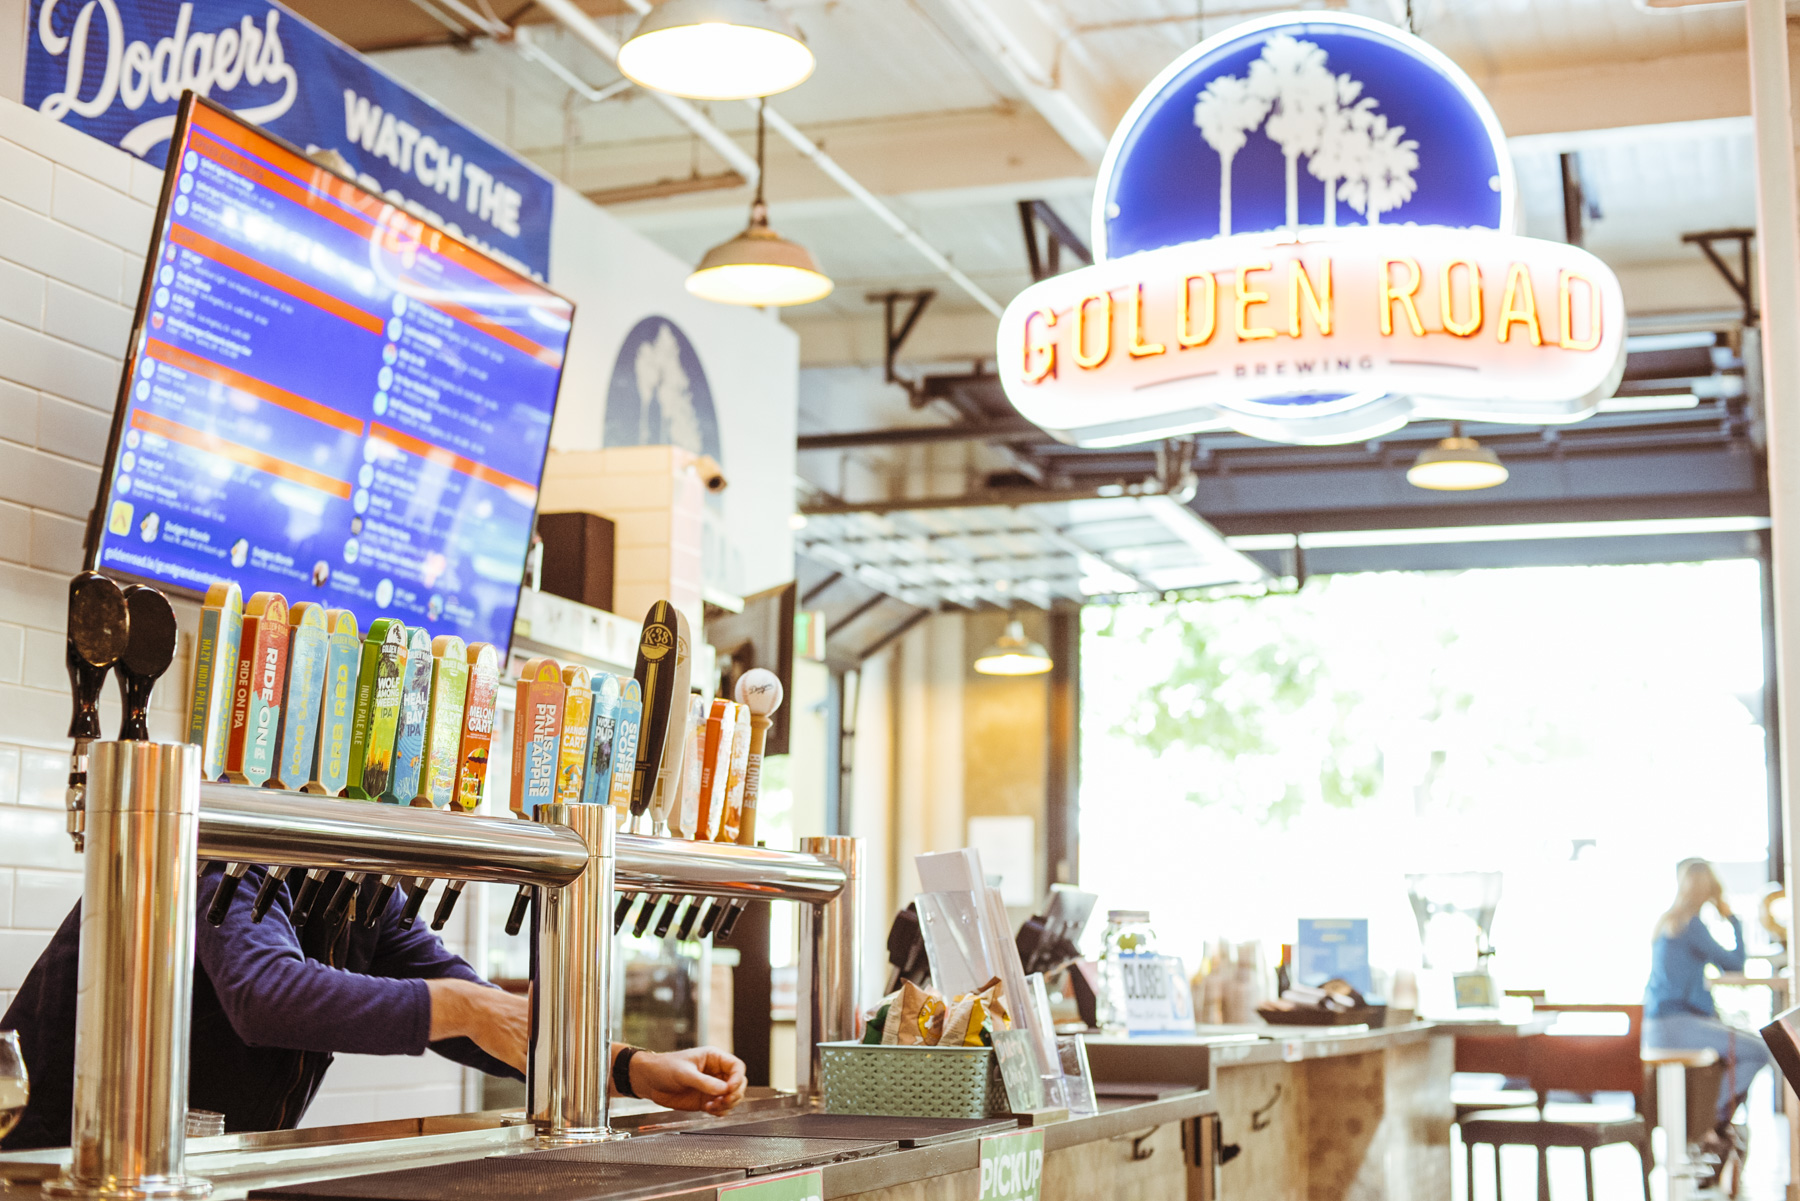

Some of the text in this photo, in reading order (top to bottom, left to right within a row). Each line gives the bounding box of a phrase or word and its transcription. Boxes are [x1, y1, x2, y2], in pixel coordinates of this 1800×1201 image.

[39, 0, 298, 125] Dodgers
[344, 88, 463, 202] WATCH
[463, 162, 522, 239] THE
[1021, 255, 1603, 386] GOLDEN ROAD
[1233, 355, 1374, 378] BREWING
[192, 639, 212, 730] HAZY INDIA PALE ALE
[233, 660, 250, 729] RIDE ON IPA
[256, 647, 278, 746] RIDE ON
[376, 688, 399, 699] AMONG
[378, 676, 401, 690] WOLF
[404, 692, 427, 706] HEAL
[354, 684, 370, 745] INDIA PALE ALE
[376, 697, 399, 708] WEEDS
[380, 707, 393, 719] IPA
[406, 710, 423, 725] BAY
[469, 705, 494, 720] MELON
[329, 663, 349, 779] GRB RED
[407, 723, 421, 737] IPA
[468, 717, 493, 734] CART
[564, 725, 587, 737] MANGO
[595, 725, 614, 741] PUP
[597, 716, 615, 728] WOLF
[291, 724, 306, 775] BOMB
[528, 703, 547, 797] PINEAPPLE
[540, 703, 557, 798] PALISADES
[563, 735, 585, 748] CART
[614, 719, 629, 793] COFFEE
[624, 722, 638, 793] SUNSET
[702, 767, 711, 788] LAGER
[745, 753, 761, 798] BLONDE
[979, 1149, 1043, 1201] PICKUP
